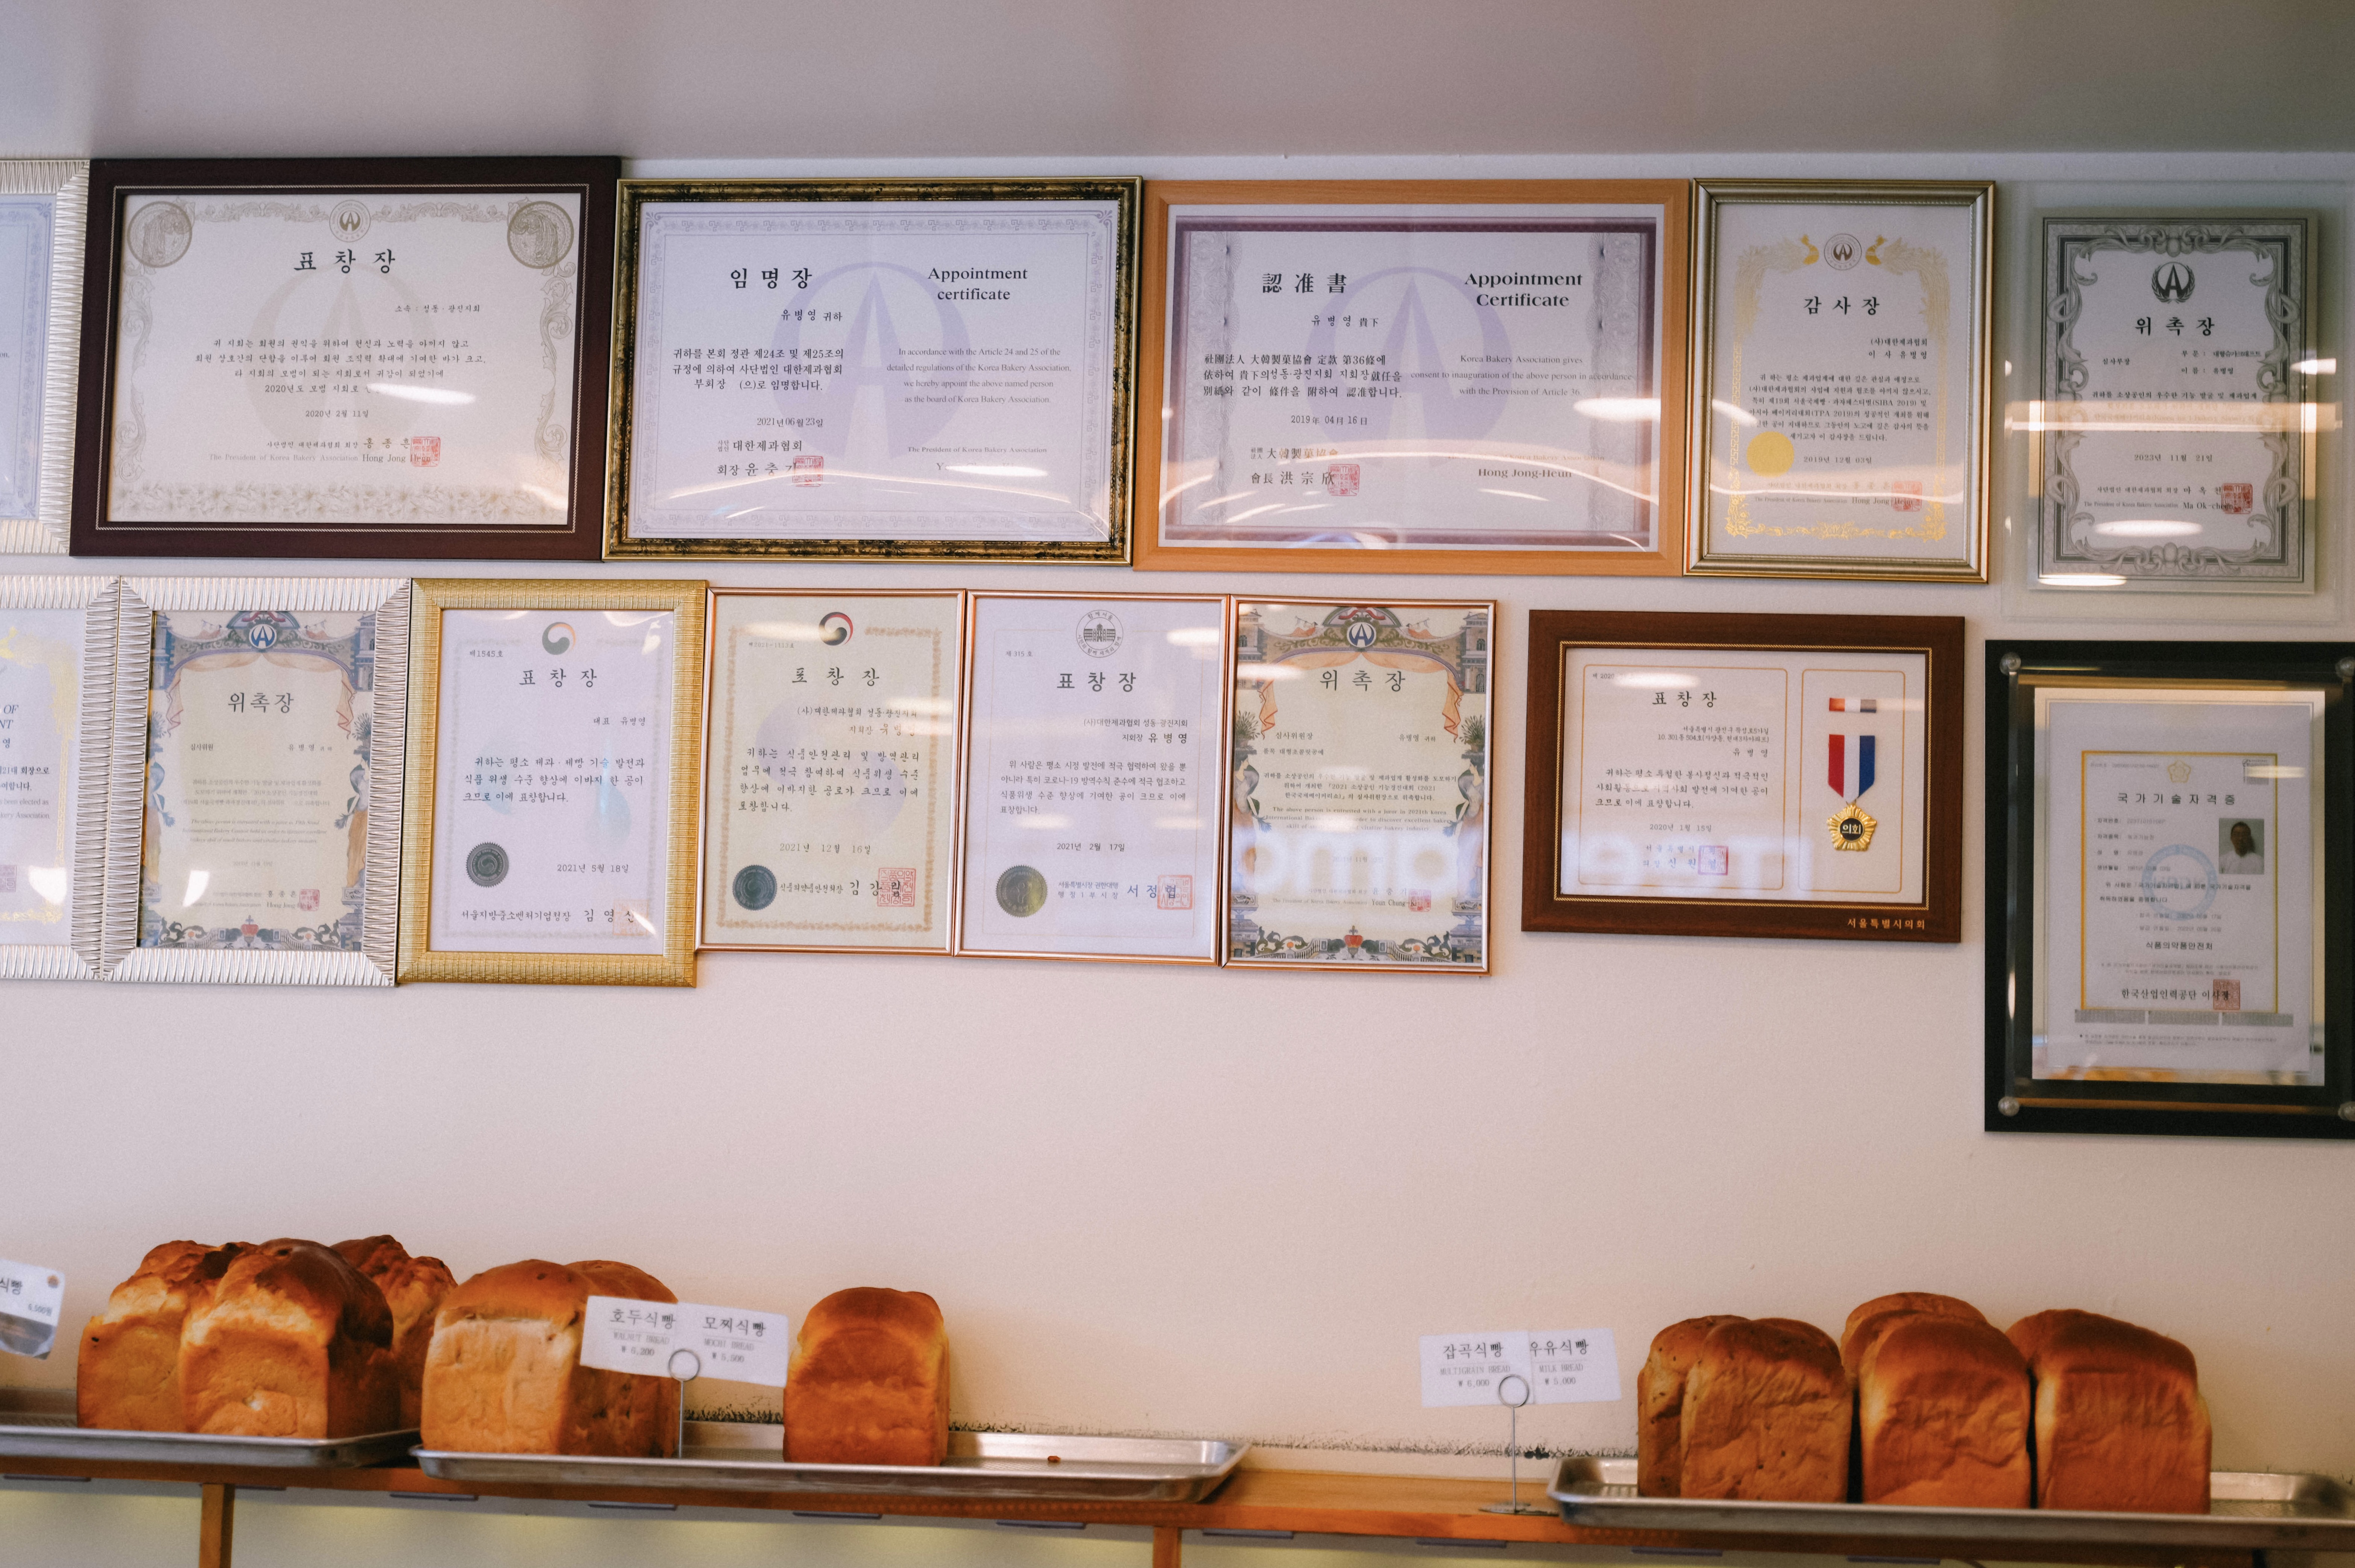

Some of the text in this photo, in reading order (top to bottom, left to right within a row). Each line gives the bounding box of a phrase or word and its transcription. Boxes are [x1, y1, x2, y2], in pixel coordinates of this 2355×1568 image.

[928, 267, 1028, 282] Appointment
[1465, 272, 1582, 288] Appointment
[937, 288, 1010, 300] certificate
[1476, 293, 1569, 306] Certificate
[673, 348, 843, 359] 귀하를 본회 정관 제24조 및 제25조의
[1486, 355, 1512, 365] Bakery
[673, 364, 842, 375] 규정에 의하여 사단법인 대한제과협회
[694, 378, 823, 391] 부회장 (으)로 임명합니다.
[916, 379, 938, 388] hereby
[1009, 760, 1186, 772] 위 사람은 평소 시정 발전에 적극 협력하여 왔을 뿐
[1841, 823, 1862, 835] 의회
[1057, 843, 1125, 852] 2021년 2월 17일
[610, 1309, 676, 1329] 호두식빵
[703, 1317, 766, 1337] 모찌식빵
[1444, 1342, 1503, 1359] 잡곡식빵
[1530, 1339, 1589, 1357] 우유식빵
